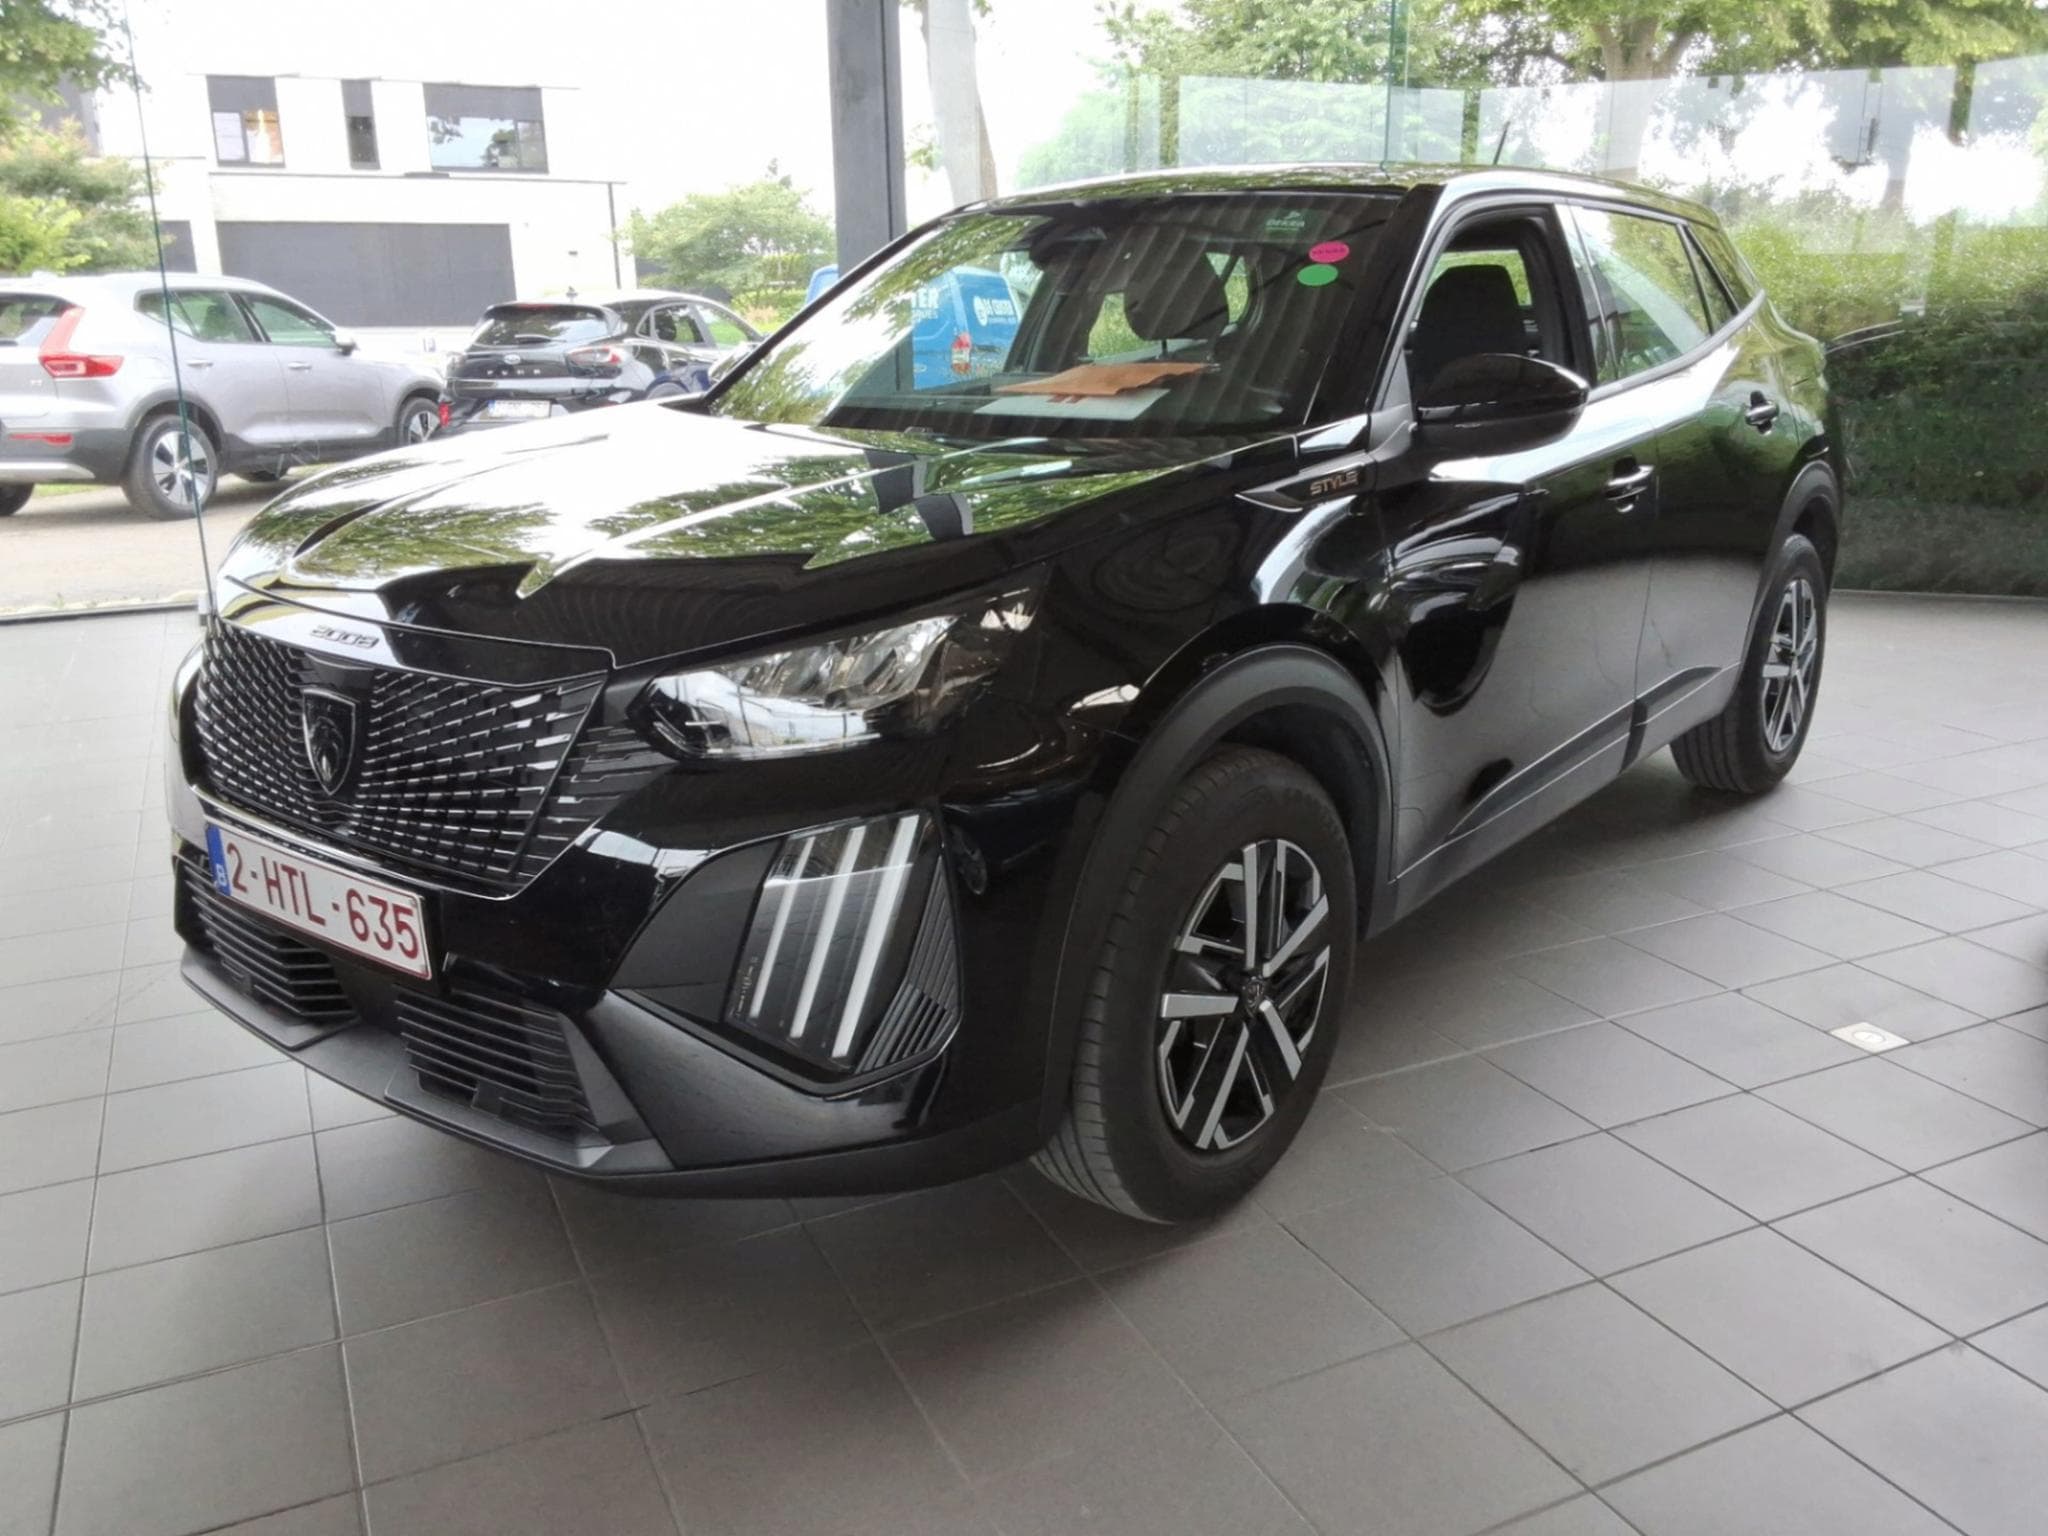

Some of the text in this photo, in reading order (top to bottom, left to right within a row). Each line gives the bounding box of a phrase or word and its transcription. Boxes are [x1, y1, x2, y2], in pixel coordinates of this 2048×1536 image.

[1309, 470, 1360, 496] STYLE
[309, 624, 380, 649] 2008
[226, 843, 419, 960] 2-HTL-635
